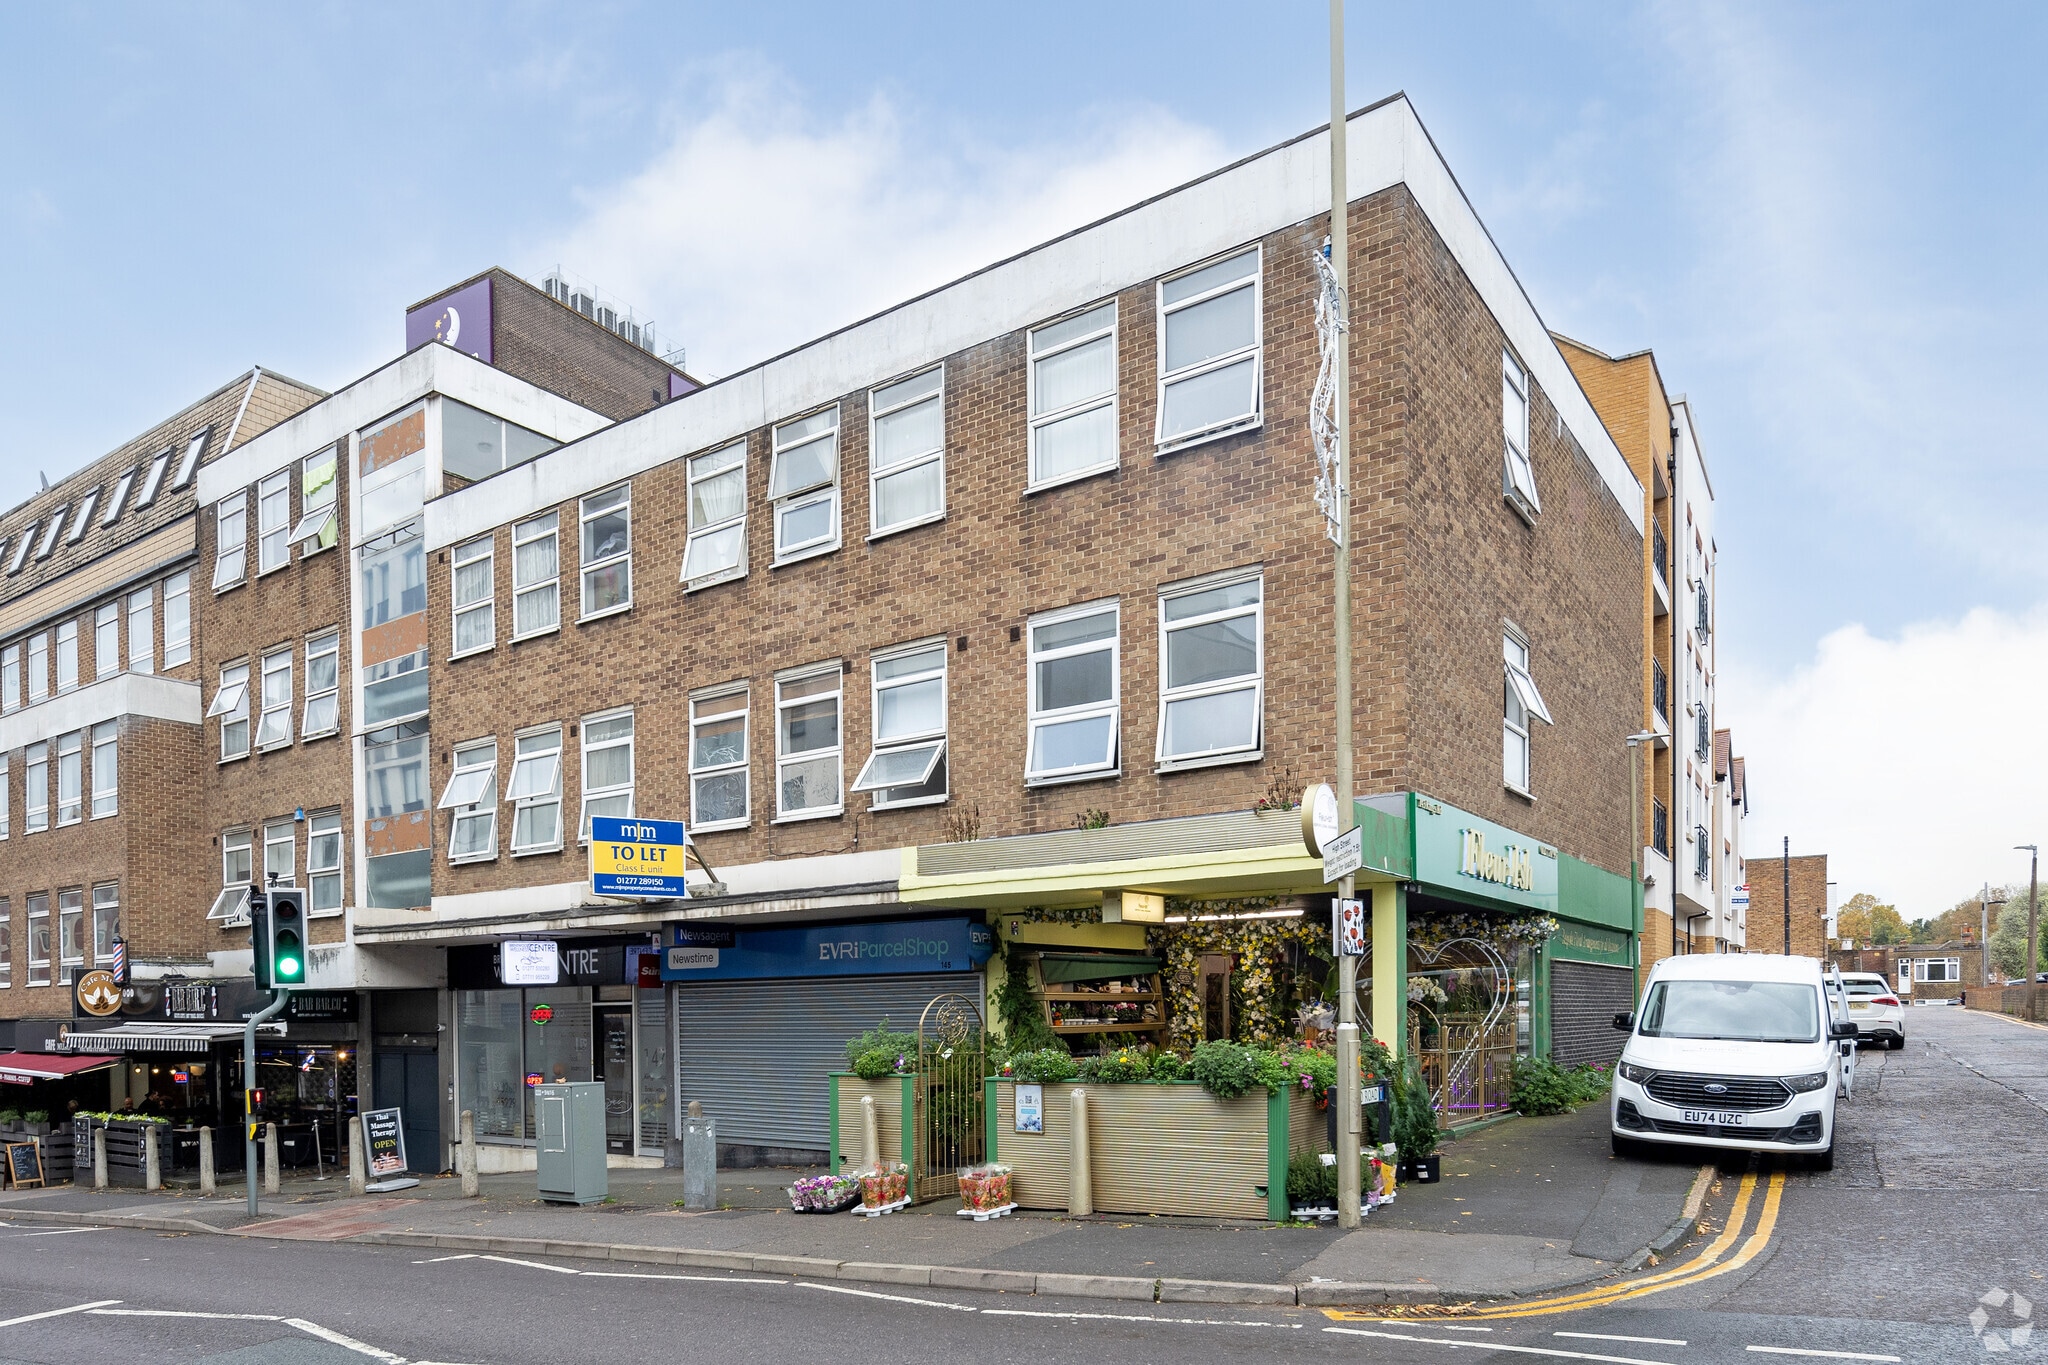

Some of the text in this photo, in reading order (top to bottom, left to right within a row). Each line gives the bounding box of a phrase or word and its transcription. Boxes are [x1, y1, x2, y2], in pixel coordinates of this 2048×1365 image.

[611, 845, 667, 862] TO LET
[615, 863, 663, 874] Class E unit
[616, 876, 664, 886] 01277 289150
[680, 928, 730, 944] Newsagent
[529, 943, 556, 953] CENTRE
[557, 949, 599, 976] NTRE
[672, 952, 714, 965] Newstime
[940, 961, 952, 969] 145
[80, 976, 98, 993] Cafe
[526, 1076, 544, 1085] OPEN
[1364, 1088, 1378, 1102] ROAD
[374, 1112, 389, 1121] Thai
[1684, 1111, 1743, 1125] EU74 UZC
[370, 1121, 396, 1130] Massage
[371, 1128, 397, 1138] Therapy
[374, 1138, 397, 1149] OPEN
